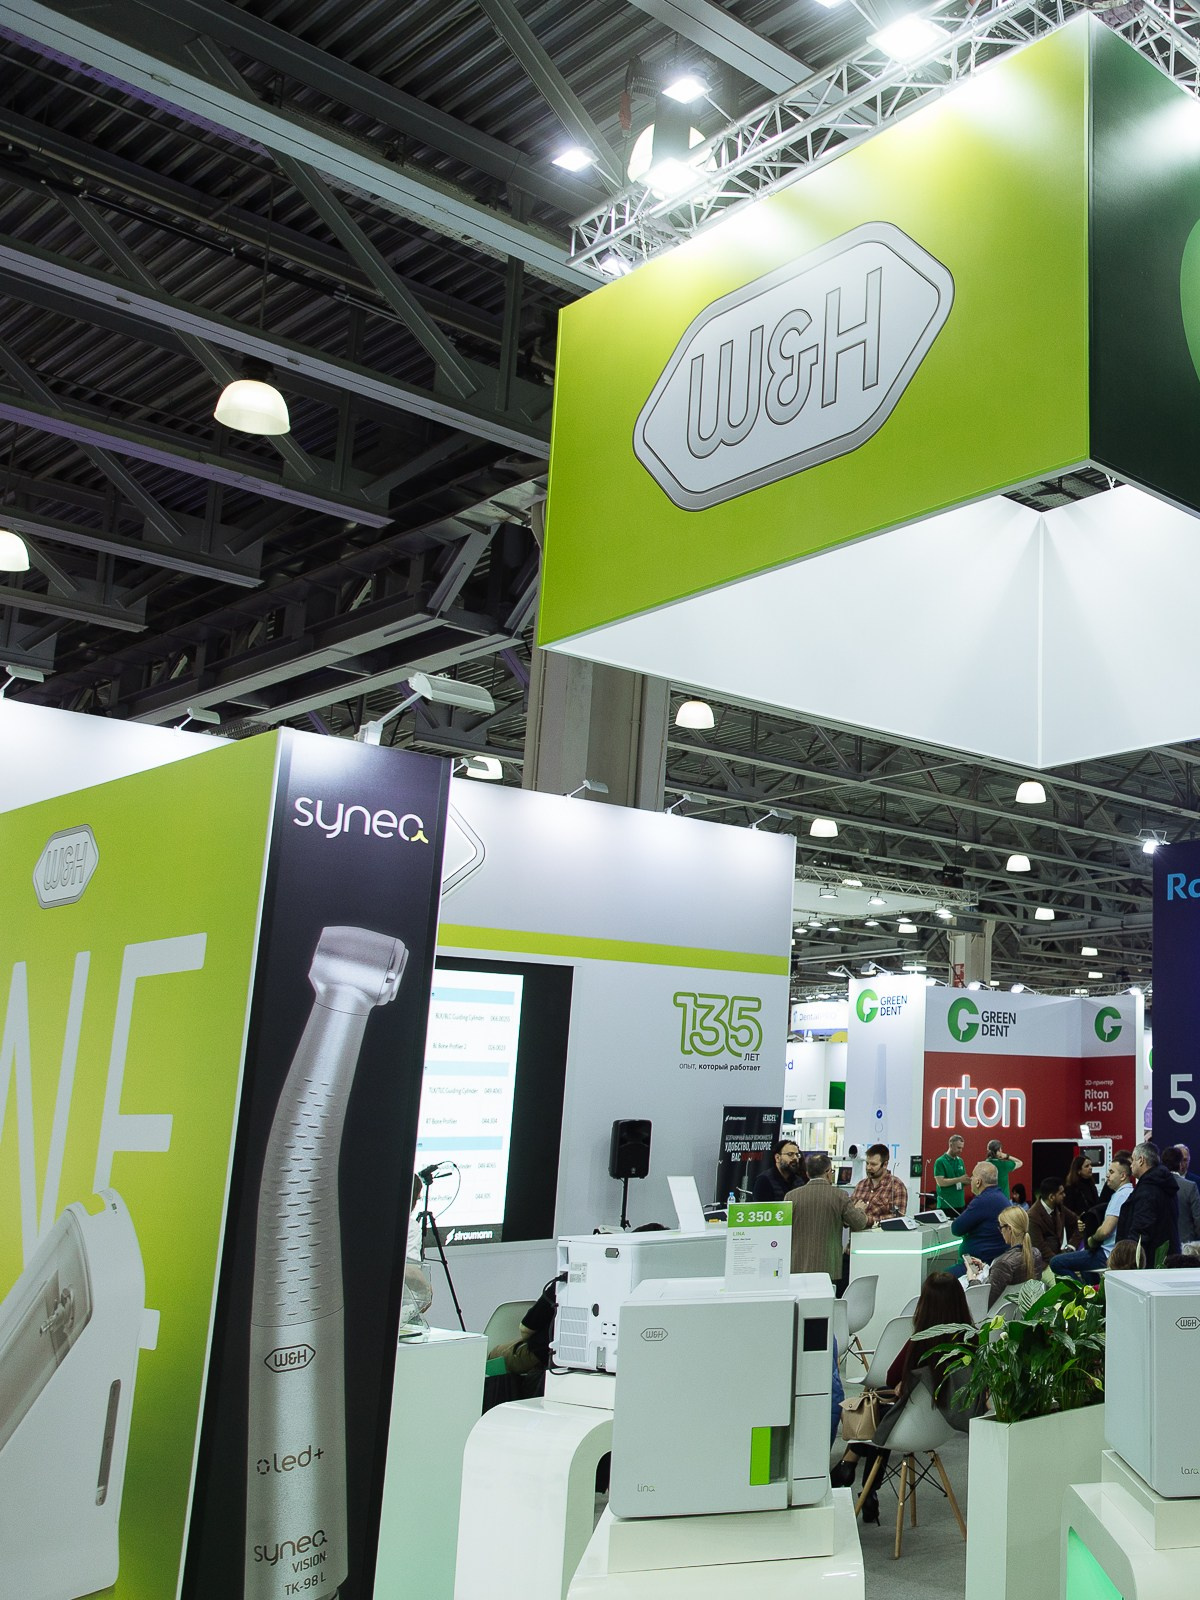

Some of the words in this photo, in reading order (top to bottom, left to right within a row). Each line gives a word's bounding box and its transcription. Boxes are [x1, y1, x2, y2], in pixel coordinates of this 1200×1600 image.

[687, 266, 882, 459] W&H
[293, 796, 429, 844] synea
[43, 841, 89, 891] W&H
[880, 995, 908, 1006] GREEN
[880, 1006, 902, 1016] DENT
[981, 1010, 1017, 1025] GREEN
[673, 991, 763, 1057] 135
[981, 1024, 1010, 1037] DENT
[744, 1053, 760, 1061] ЛЕТ
[698, 1063, 728, 1071] который
[1085, 1088, 1109, 1099] Riton
[931, 1074, 1026, 1129] riton
[1084, 1101, 1113, 1112] M-150
[736, 1211, 744, 1223] 3
[748, 1210, 772, 1222] 350
[775, 1210, 784, 1222] €
[454, 1230, 493, 1241] straumann
[1180, 1319, 1197, 1327] W&H
[645, 1330, 664, 1339] W&H
[273, 1349, 307, 1368] W&H
[1180, 1466, 1200, 1475] lara
[637, 1483, 656, 1493] lina
[253, 1530, 328, 1567] synea
[291, 1551, 327, 1574] VISION
[284, 1573, 319, 1596] TK-98
[320, 1571, 327, 1583] L
